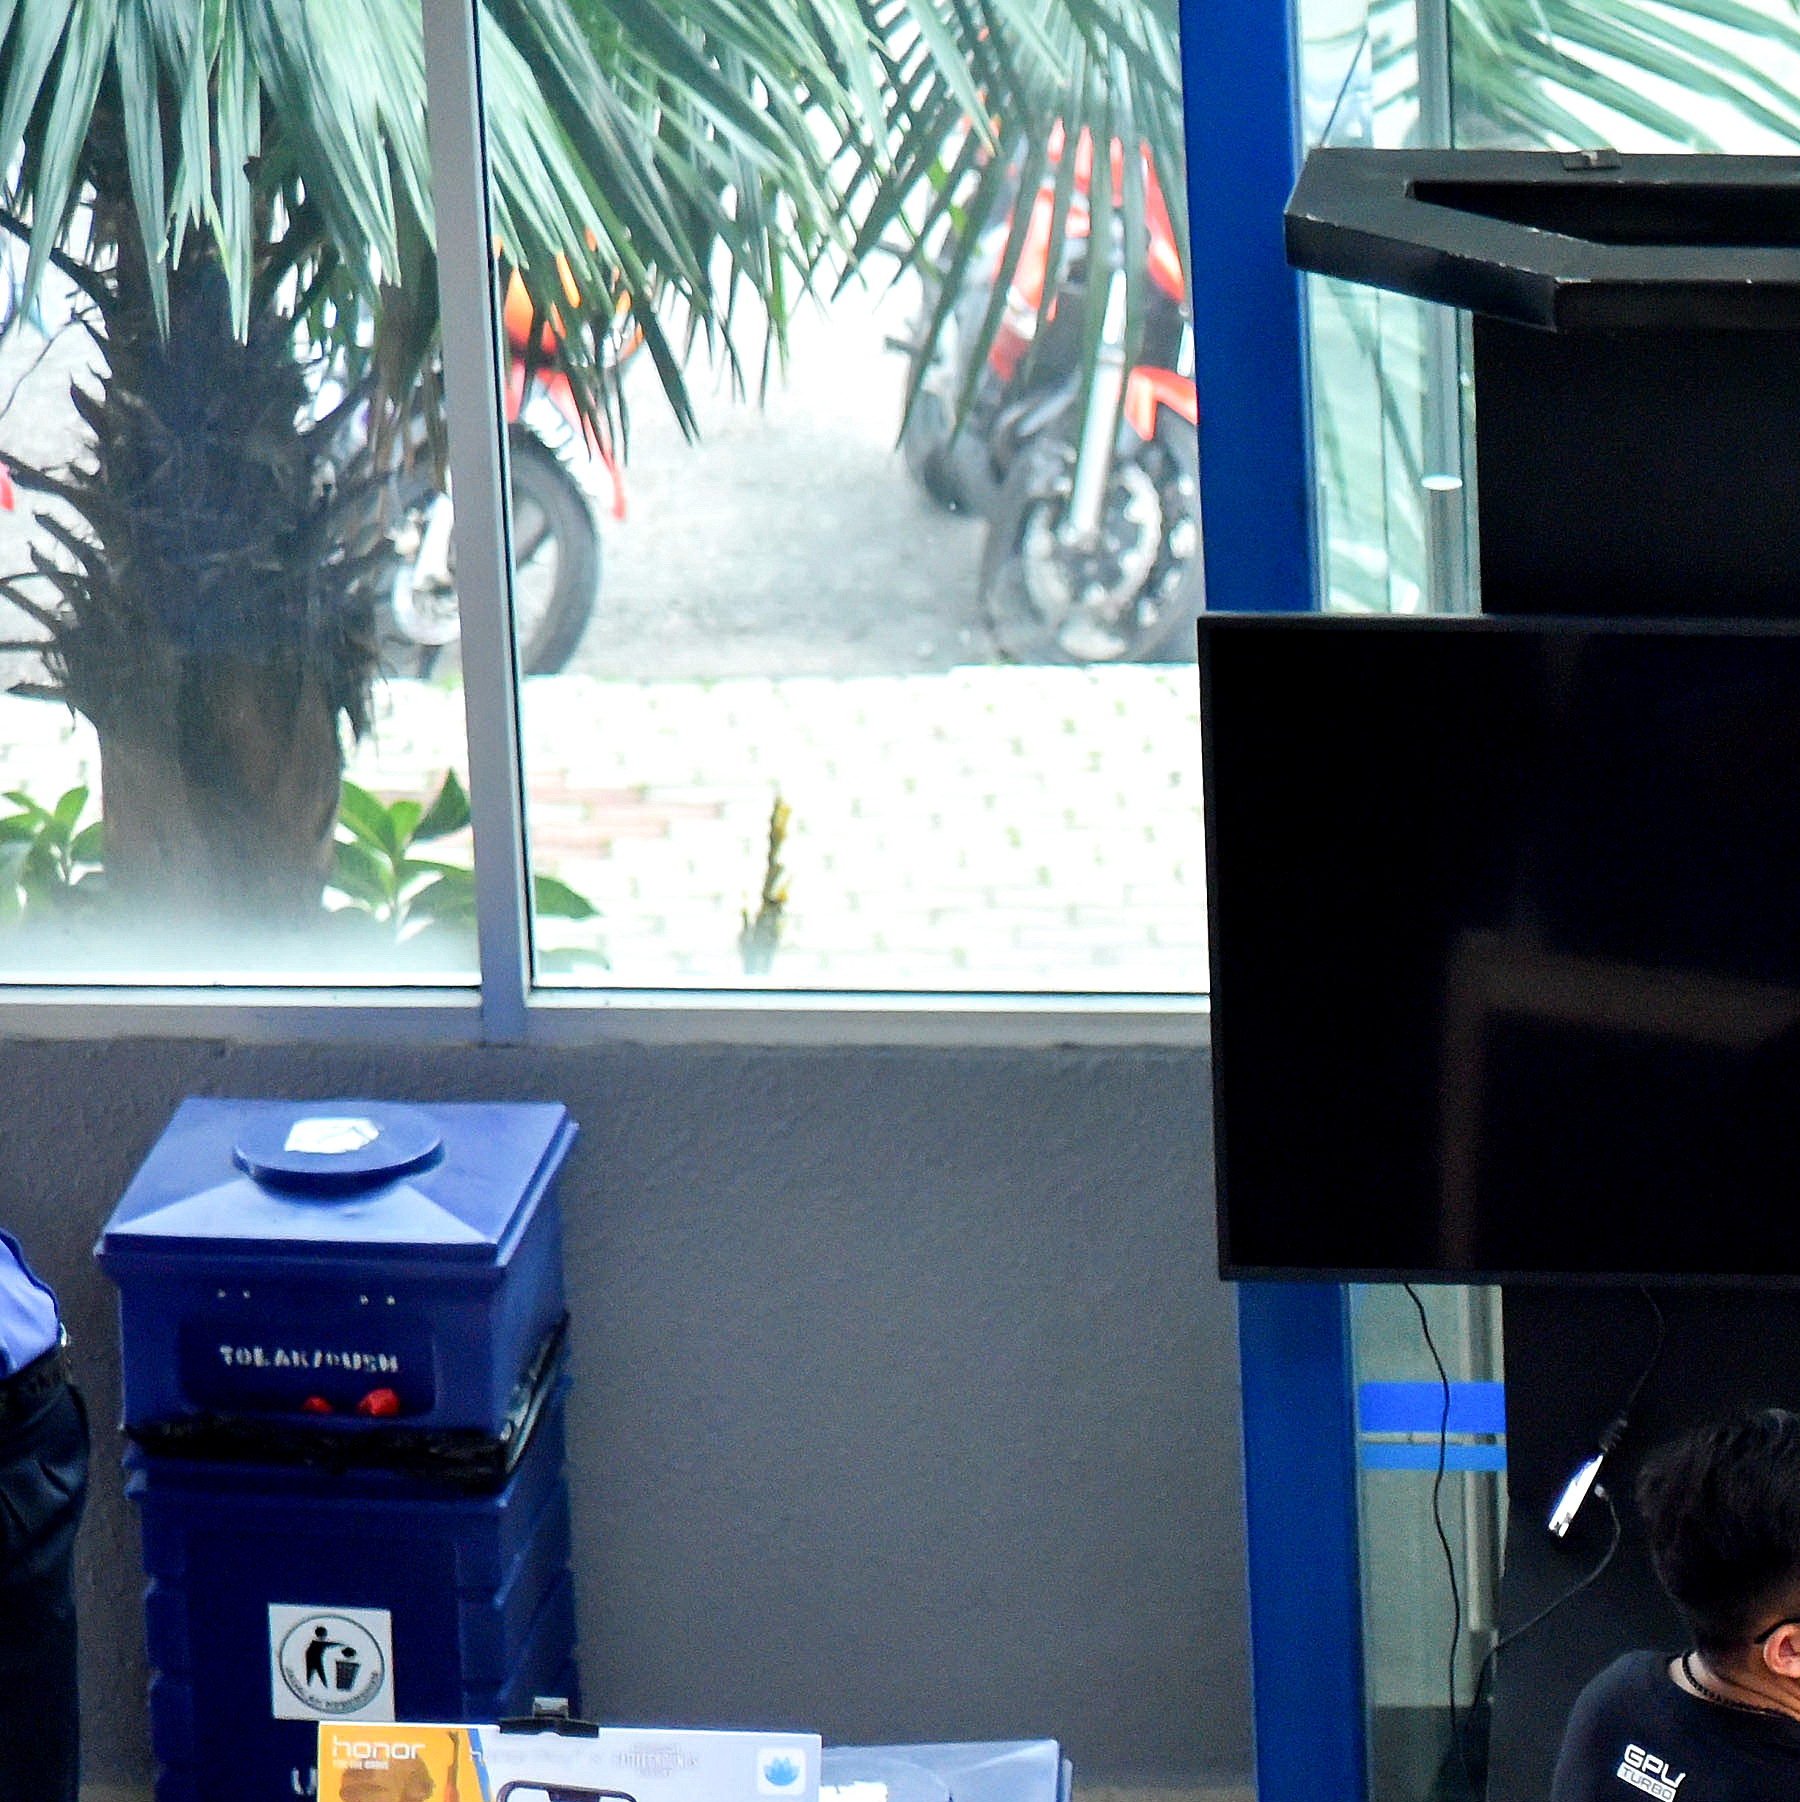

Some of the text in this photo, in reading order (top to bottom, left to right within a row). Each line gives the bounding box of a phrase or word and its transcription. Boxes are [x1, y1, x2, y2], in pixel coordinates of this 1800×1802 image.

[332, 1735, 426, 1760] honor
[1624, 1744, 1686, 1789] GPU
[1621, 1767, 1675, 1802] TURBO
